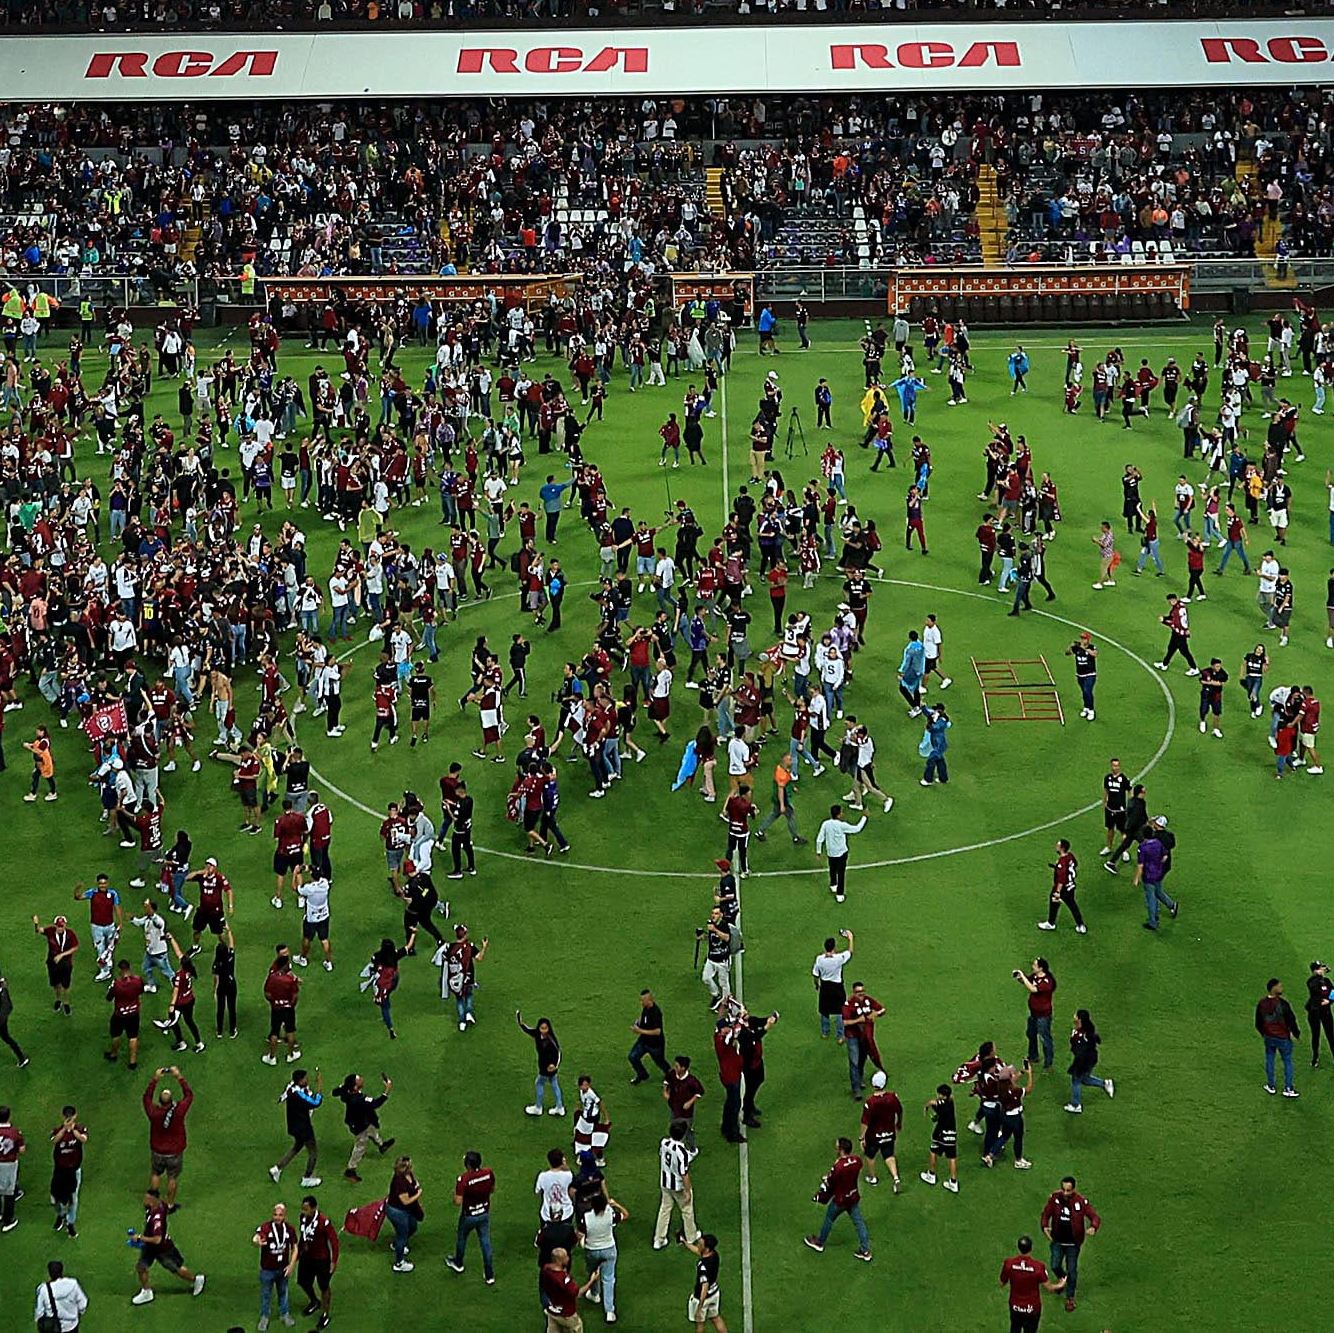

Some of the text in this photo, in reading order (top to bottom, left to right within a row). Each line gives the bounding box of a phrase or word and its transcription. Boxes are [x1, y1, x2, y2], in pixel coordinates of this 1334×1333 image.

[86, 51, 278, 78] RCA
[458, 47, 649, 73] RCA
[829, 42, 1021, 69] RCA
